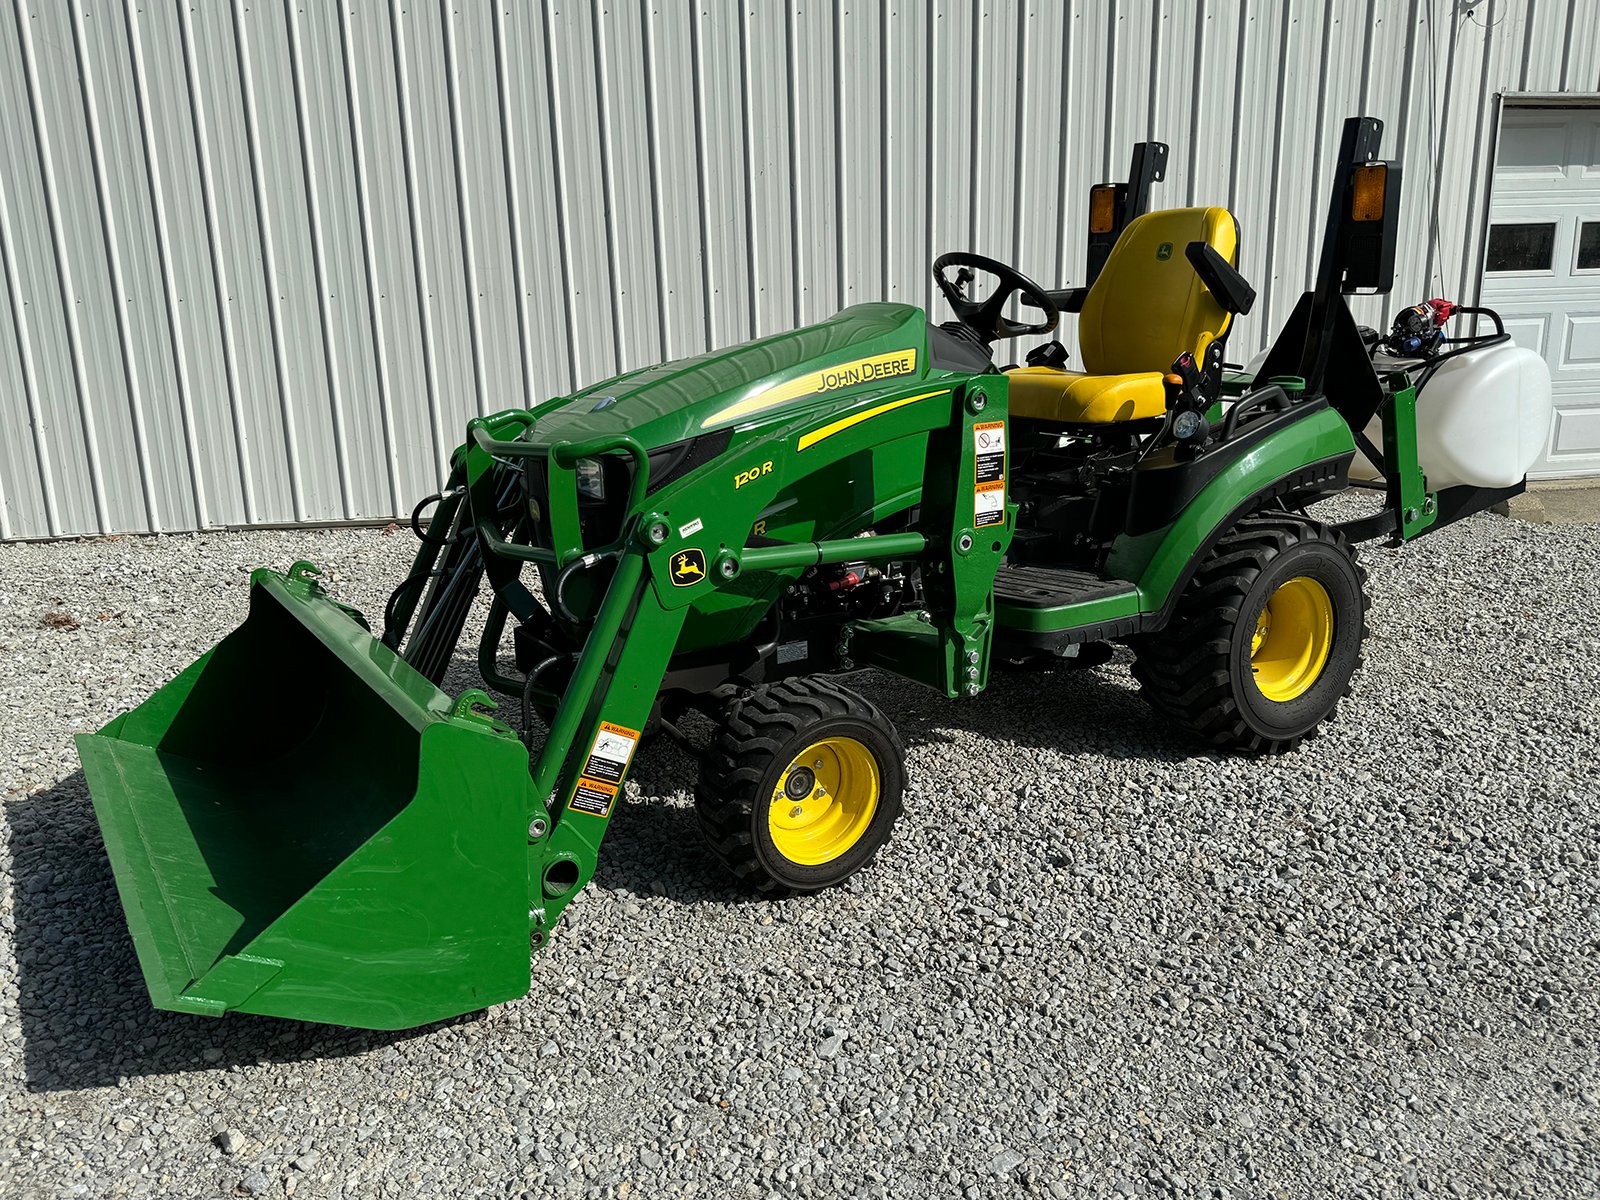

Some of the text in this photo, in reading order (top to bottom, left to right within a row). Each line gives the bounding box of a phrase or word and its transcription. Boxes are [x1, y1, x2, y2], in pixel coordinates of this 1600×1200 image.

[818, 359, 910, 391] JOHN DEERE
[980, 422, 1003, 430] WARNING
[981, 483, 1004, 492] WARNING
[611, 726, 635, 738] WARNING
[588, 781, 613, 793] WARNING
